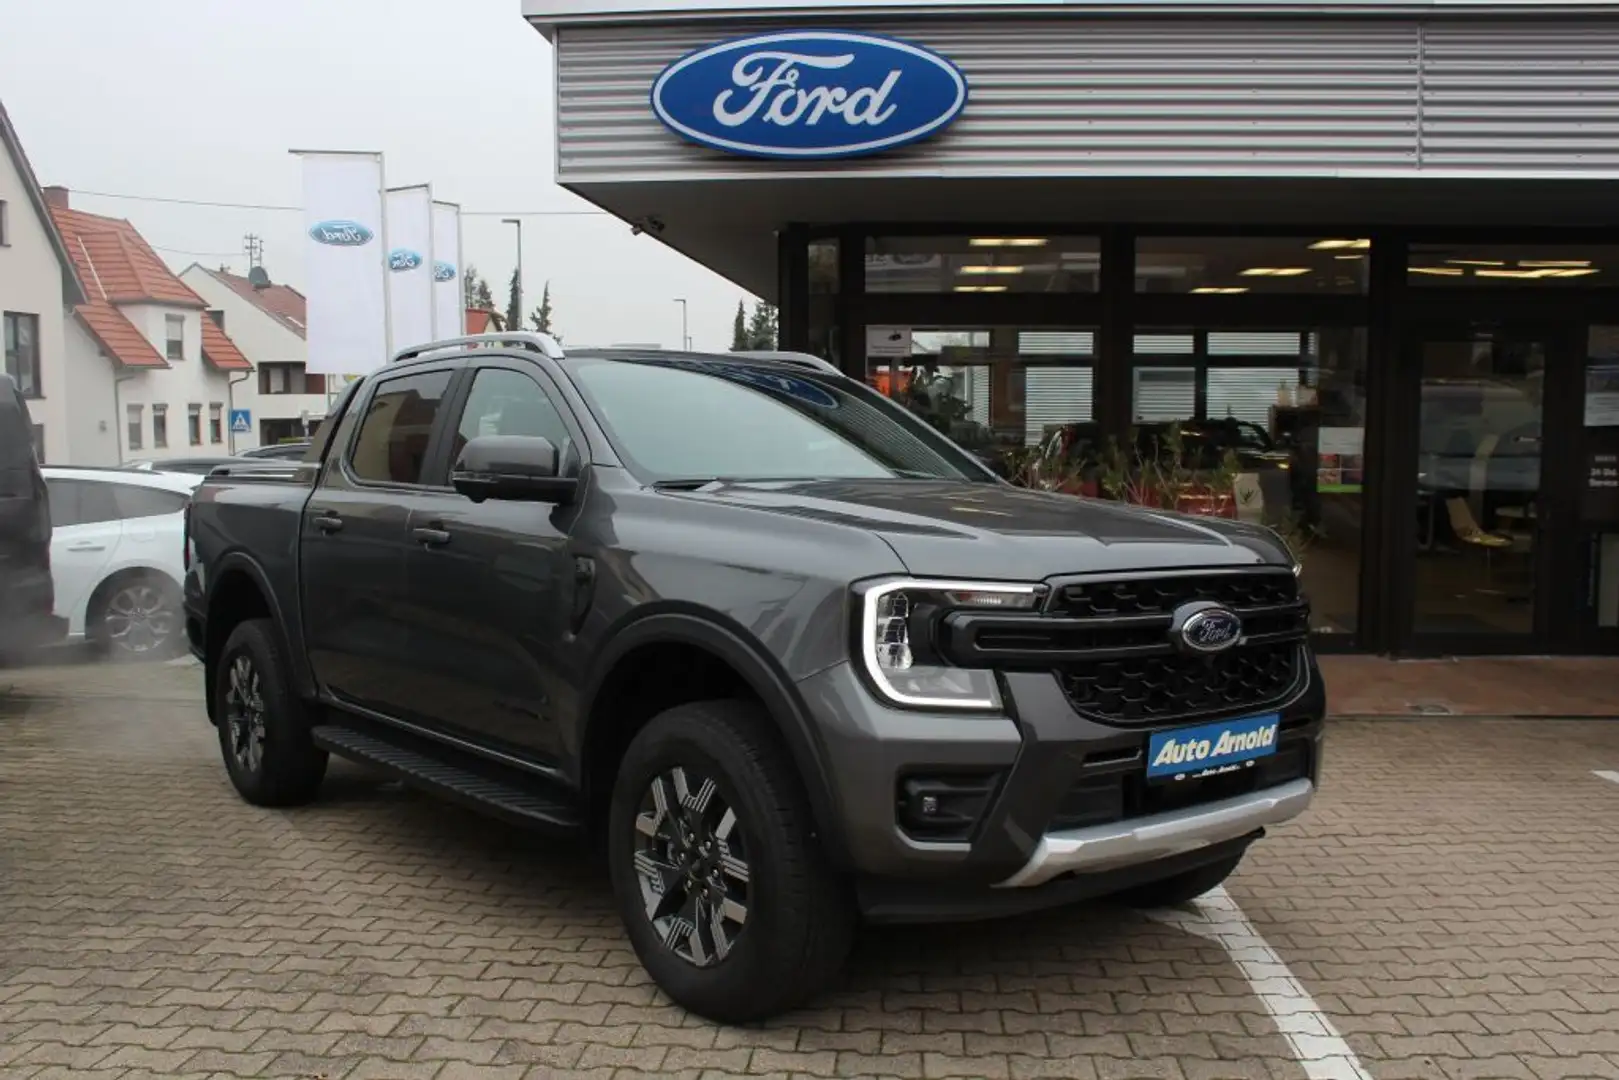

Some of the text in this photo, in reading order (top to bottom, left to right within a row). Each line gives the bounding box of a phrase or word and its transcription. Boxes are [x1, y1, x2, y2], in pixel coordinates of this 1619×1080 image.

[712, 51, 902, 127] Ford
[1199, 618, 1232, 642] Ford
[1152, 724, 1279, 767] Auto Arnold
